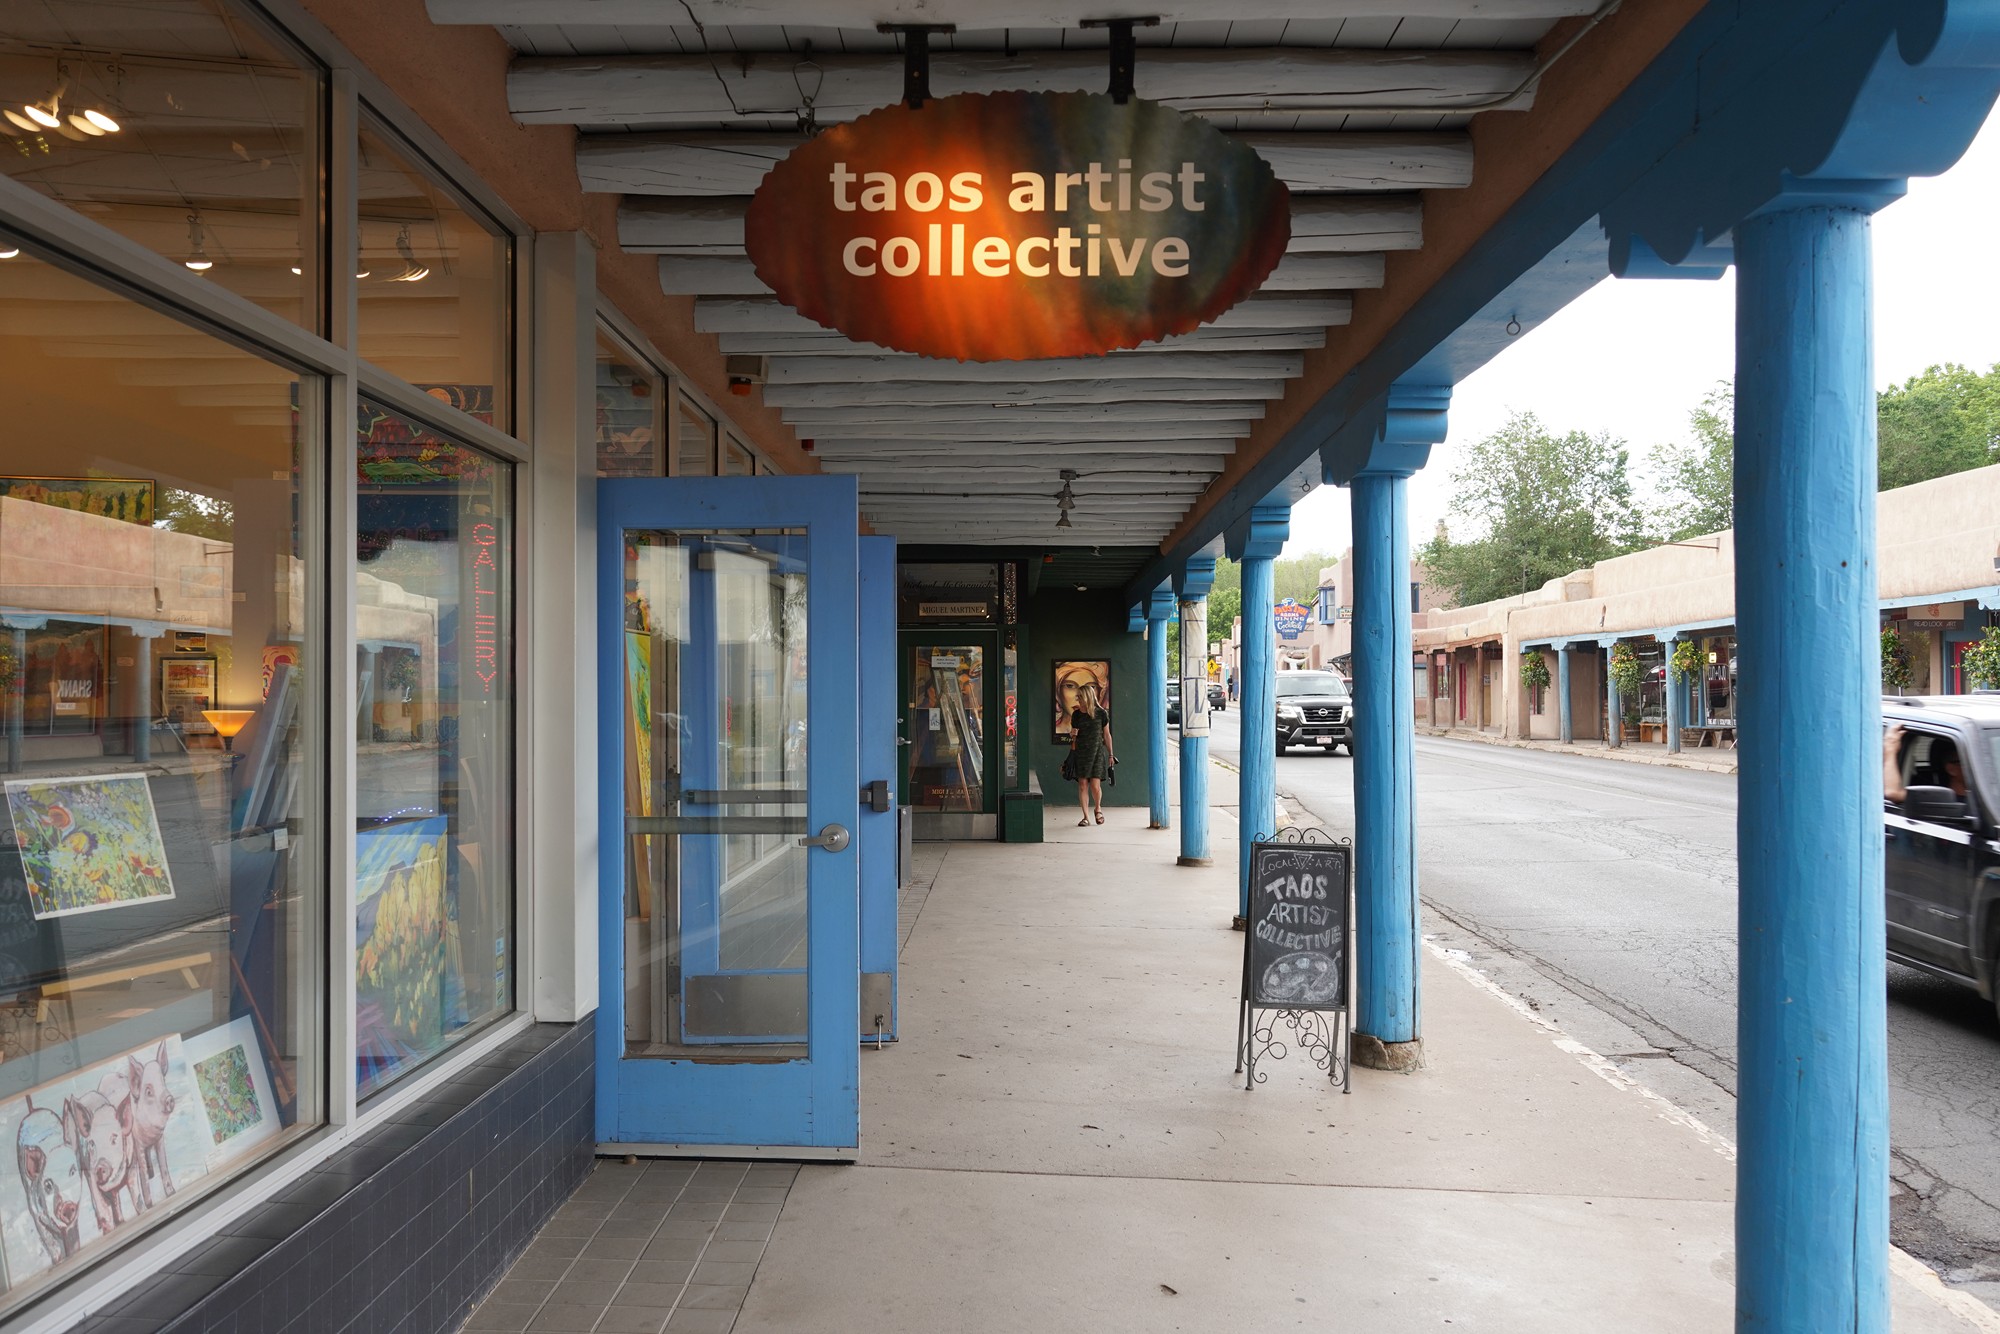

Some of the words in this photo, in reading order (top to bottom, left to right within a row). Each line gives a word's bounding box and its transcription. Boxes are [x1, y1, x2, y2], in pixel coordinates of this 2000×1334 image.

[829, 162, 983, 213] taos
[1007, 158, 1206, 213] artist
[842, 223, 1191, 277] collective
[473, 523, 497, 692] GALLERY
[922, 606, 948, 614] MIGUEL
[949, 606, 984, 614] MARTINEZ
[1261, 853, 1293, 876] LOCAL
[1264, 873, 1329, 900] TAOS
[1266, 901, 1338, 926] ARTIST
[1256, 919, 1342, 950] COLLECTIVE
